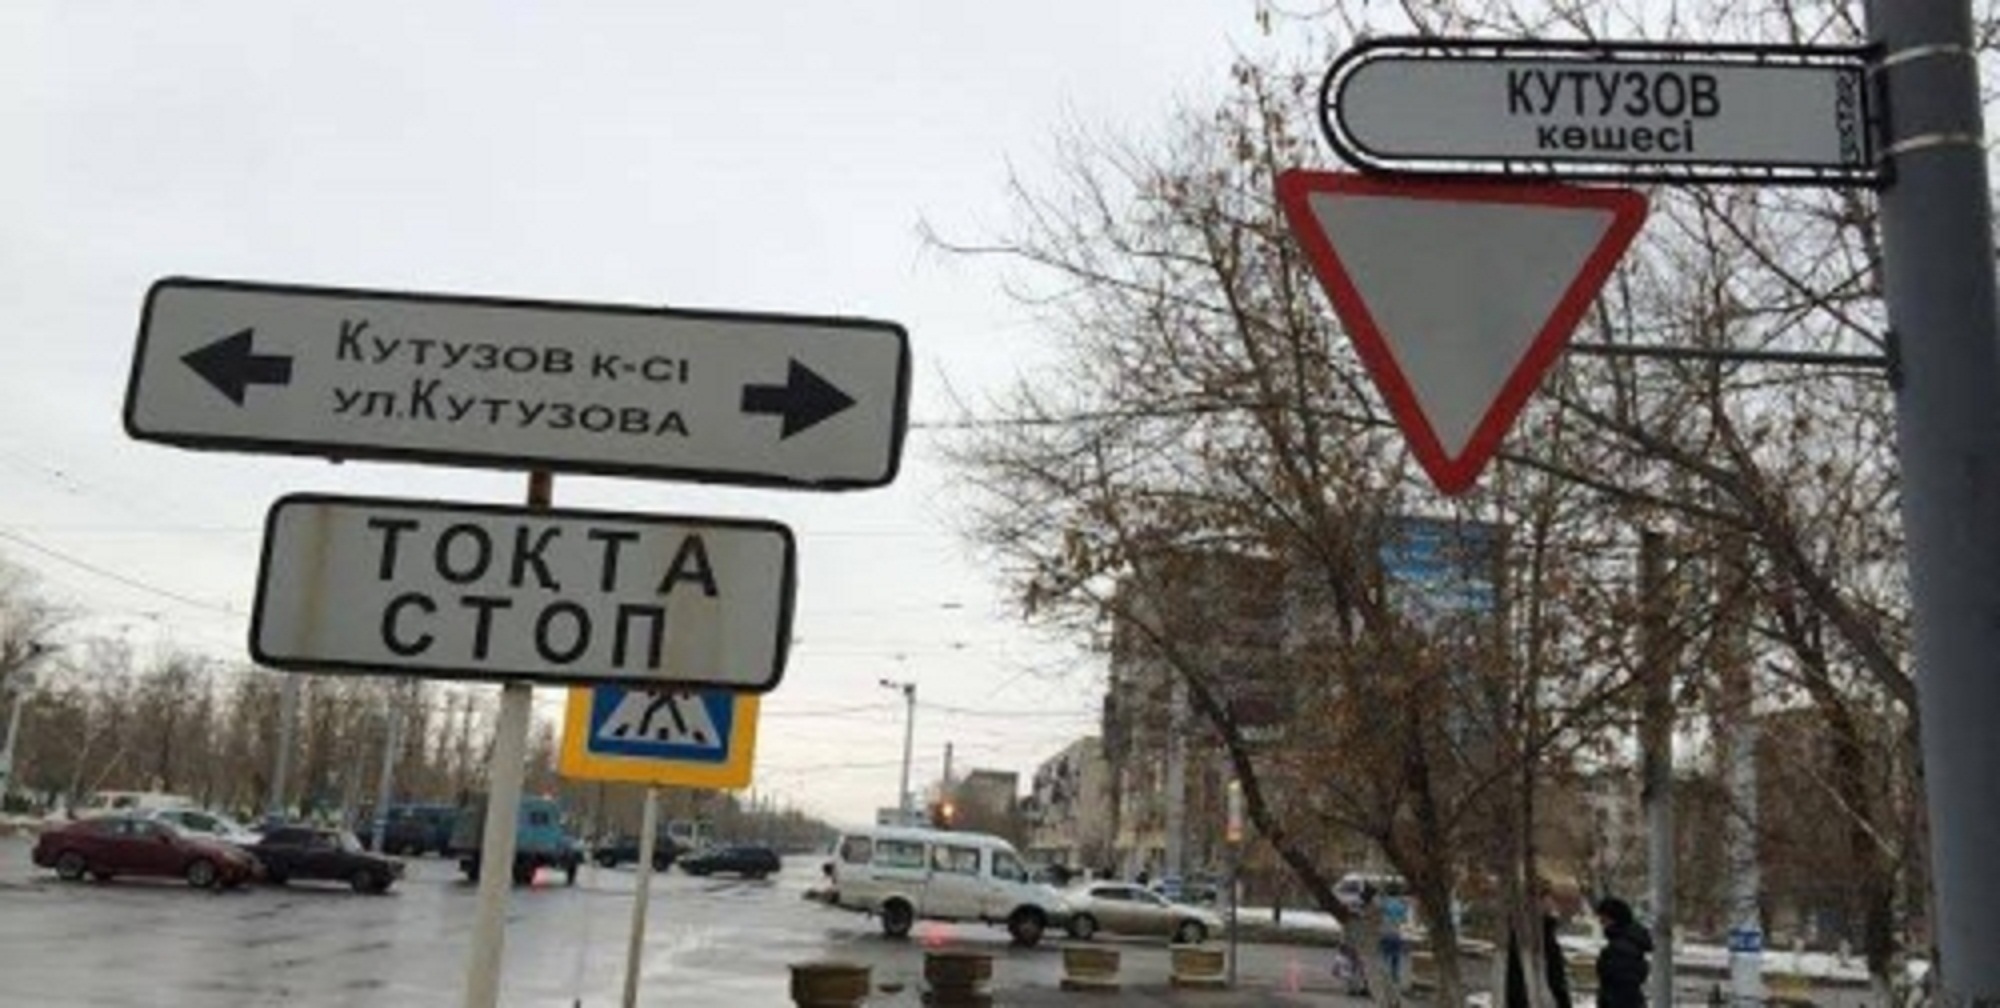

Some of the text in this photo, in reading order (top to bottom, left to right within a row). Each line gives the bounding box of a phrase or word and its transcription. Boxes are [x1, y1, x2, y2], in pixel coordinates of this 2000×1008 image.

[1507, 69, 1722, 118] КУТУЗОВ
[1536, 119, 1695, 153] көшесі
[367, 516, 718, 598] ТОҚТА
[380, 591, 666, 670] СТОП
